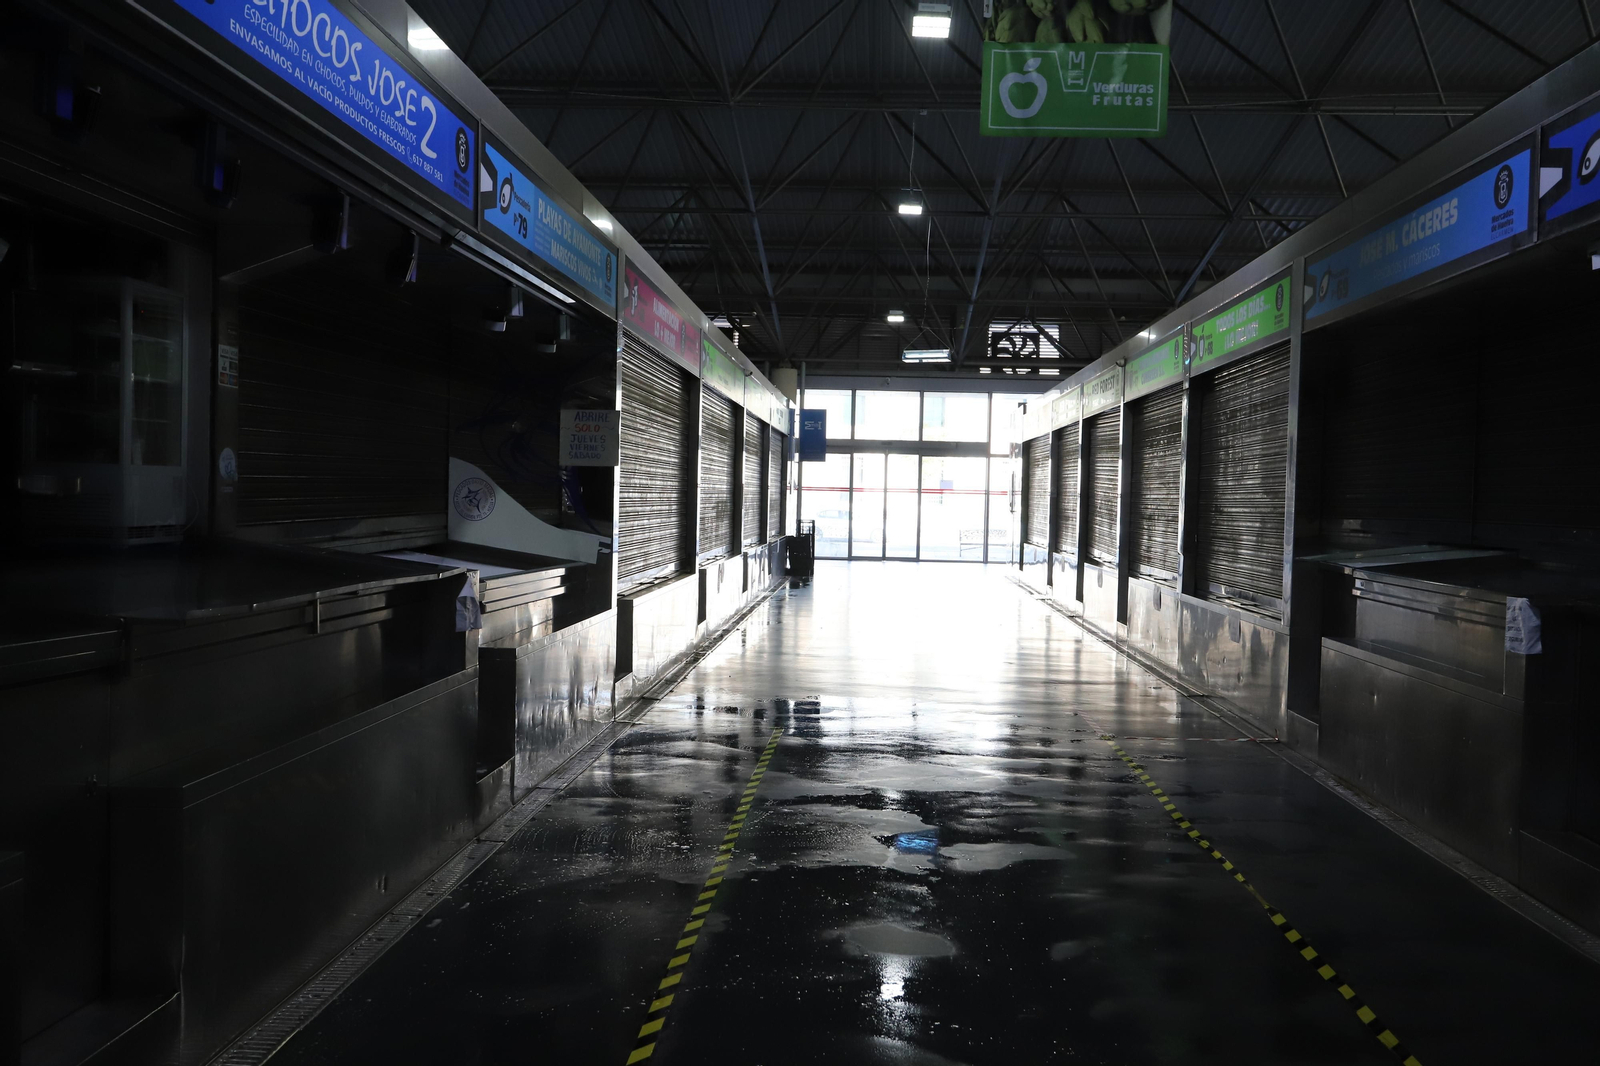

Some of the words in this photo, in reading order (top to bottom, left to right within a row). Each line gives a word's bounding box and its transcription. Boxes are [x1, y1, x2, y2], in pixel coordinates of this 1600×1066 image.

[244, 4, 299, 56] ESPECILIDAD
[302, 49, 313, 67] EN
[315, 60, 347, 96] CHOCOS,
[349, 84, 374, 114] PULPOS
[375, 105, 380, 119] Y
[381, 109, 417, 146] ELABORADOS
[1093, 82, 1154, 94] Verduras
[230, 18, 292, 73] ENVASAMOS
[294, 68, 306, 84] AL
[335, 96, 377, 135] PRODUCTOS
[379, 129, 405, 155] FRESCOS
[412, 153, 423, 167] 617
[423, 161, 433, 175] 887
[434, 169, 444, 182] 581
[1092, 95, 1154, 106] Frutas
[368, 60, 418, 126] JOSE
[420, 96, 437, 159] 2
[1491, 208, 1515, 224] Mercados
[538, 198, 562, 236] PLAYAS
[563, 219, 571, 244] DE
[573, 228, 601, 267] AYAMONTE
[1385, 231, 1398, 255] M.
[1402, 197, 1459, 247] CÁCERES
[1491, 224, 1496, 233] de
[551, 239, 577, 273] MARISCOS
[578, 258, 592, 283] VIVOS
[1408, 243, 1441, 267] mariscos
[574, 423, 600, 433] SOLO
[570, 433, 606, 443] JUEVES
[568, 451, 602, 460] SABADO
[569, 443, 605, 452] VIERNES
